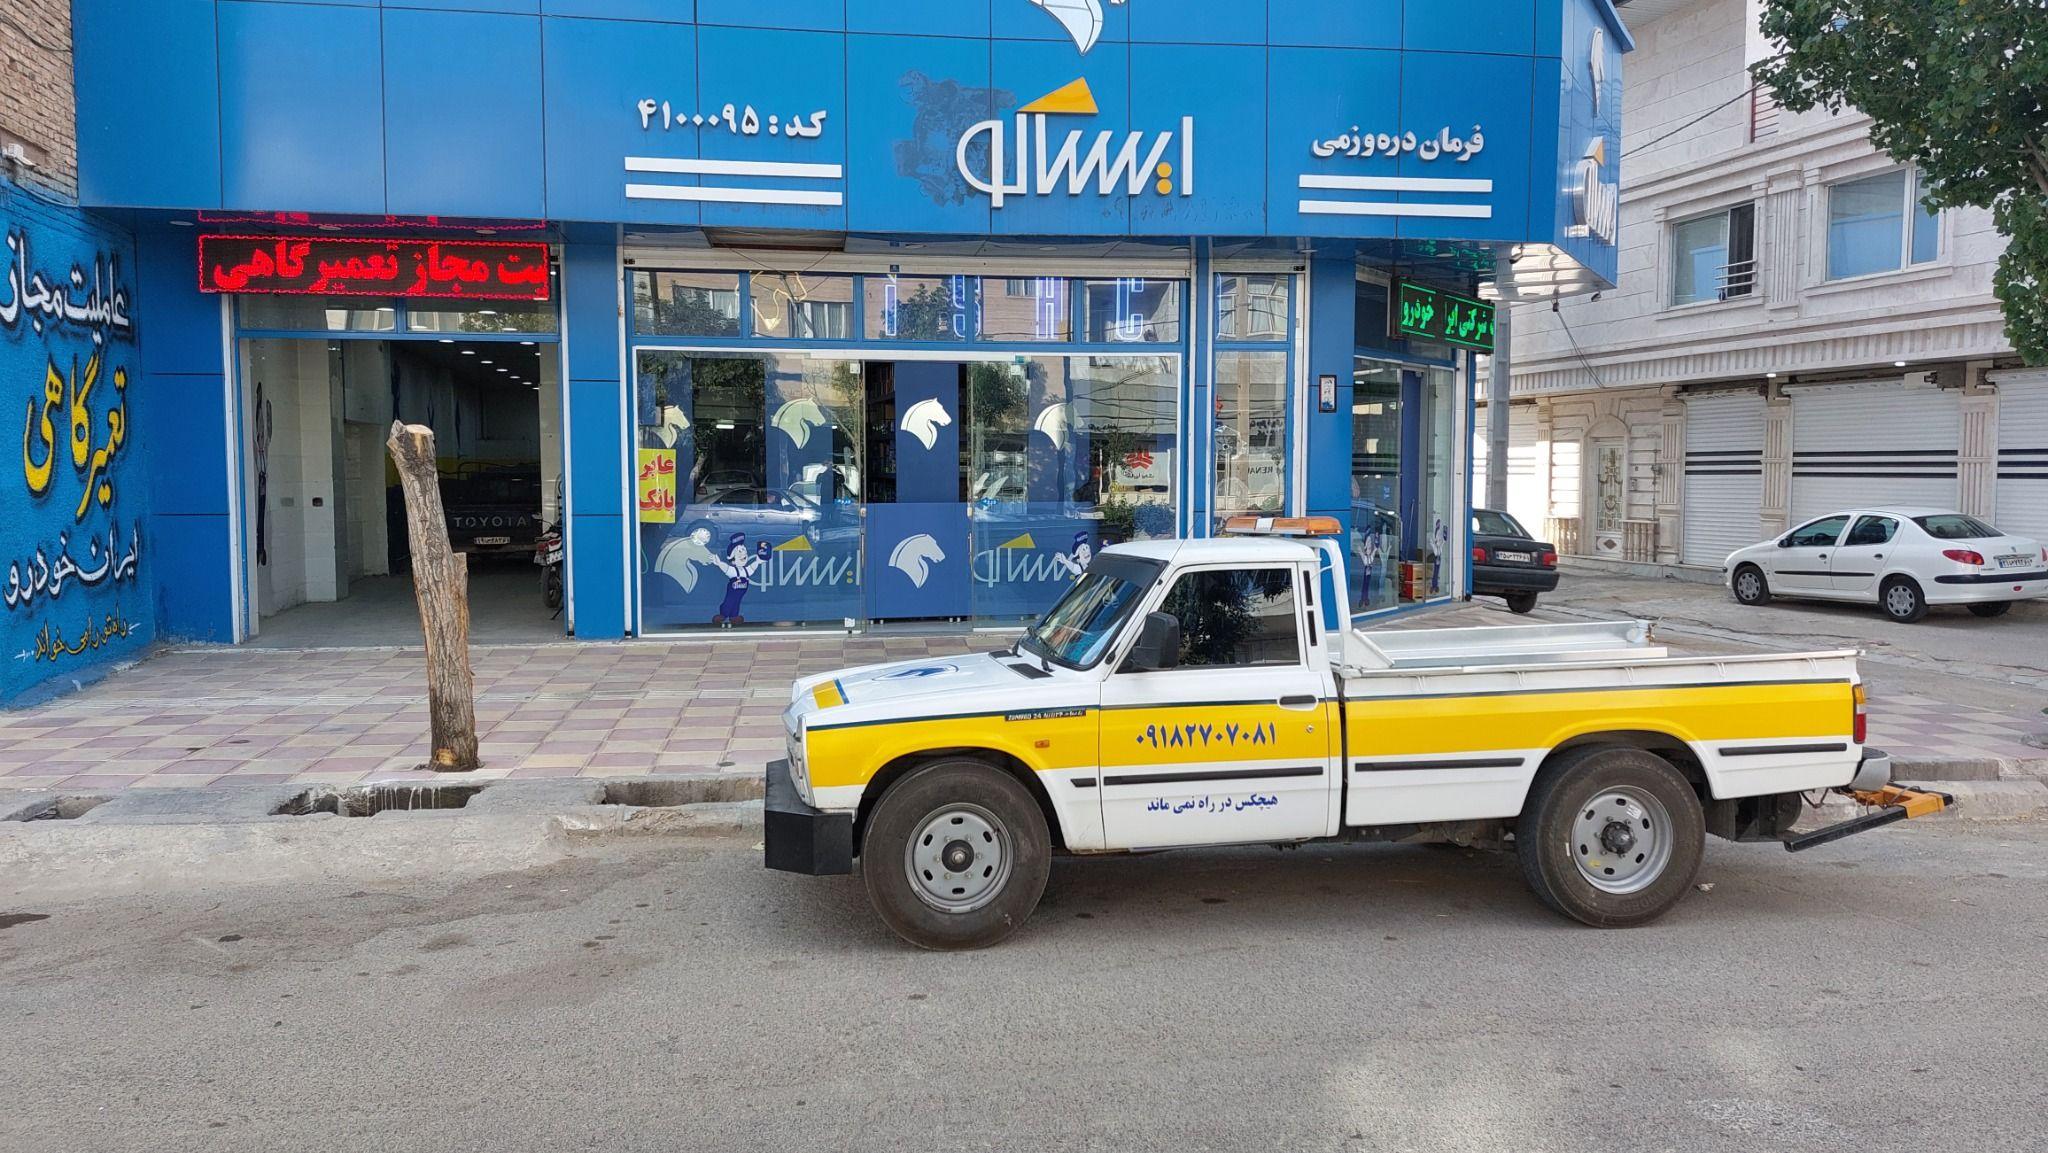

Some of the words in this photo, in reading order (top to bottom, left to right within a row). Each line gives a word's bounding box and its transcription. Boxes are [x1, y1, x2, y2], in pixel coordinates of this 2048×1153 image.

[637, 99, 760, 135] ۴۱۰۰۰۹۵
[1419, 125, 1485, 162] فرمان
[406, 244, 490, 295] مجاز
[64, 258, 130, 346] عاملیت
[639, 454, 675, 481] عابر
[639, 488, 675, 519] بانک
[452, 516, 528, 529] TOYOTA
[3, 534, 76, 606] خودرو
[76, 527, 139, 582] ایران
[1136, 721, 1277, 749] ۰۹۱۸۲۷۰۷۰۸۱
[1197, 795, 1216, 813] راه
[1218, 797, 1232, 813] در
[1235, 793, 1279, 811] هیچکس
